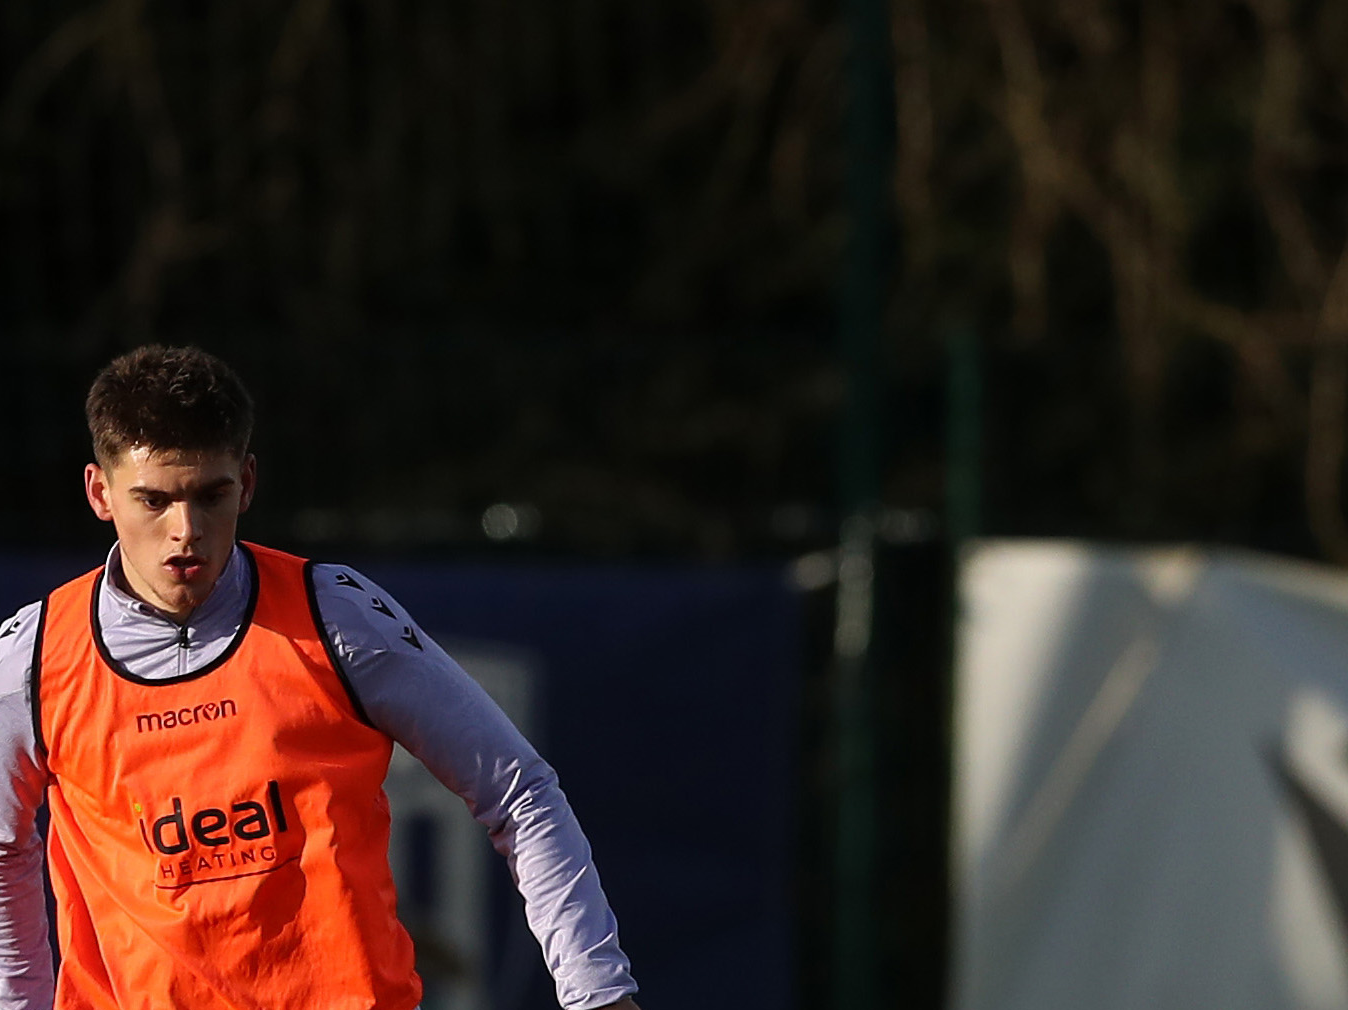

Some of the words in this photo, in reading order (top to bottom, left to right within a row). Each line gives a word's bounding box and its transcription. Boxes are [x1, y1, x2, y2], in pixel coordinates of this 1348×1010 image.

[136, 699, 237, 733] macron
[135, 779, 288, 855] ideal
[160, 846, 277, 879] HEATING
